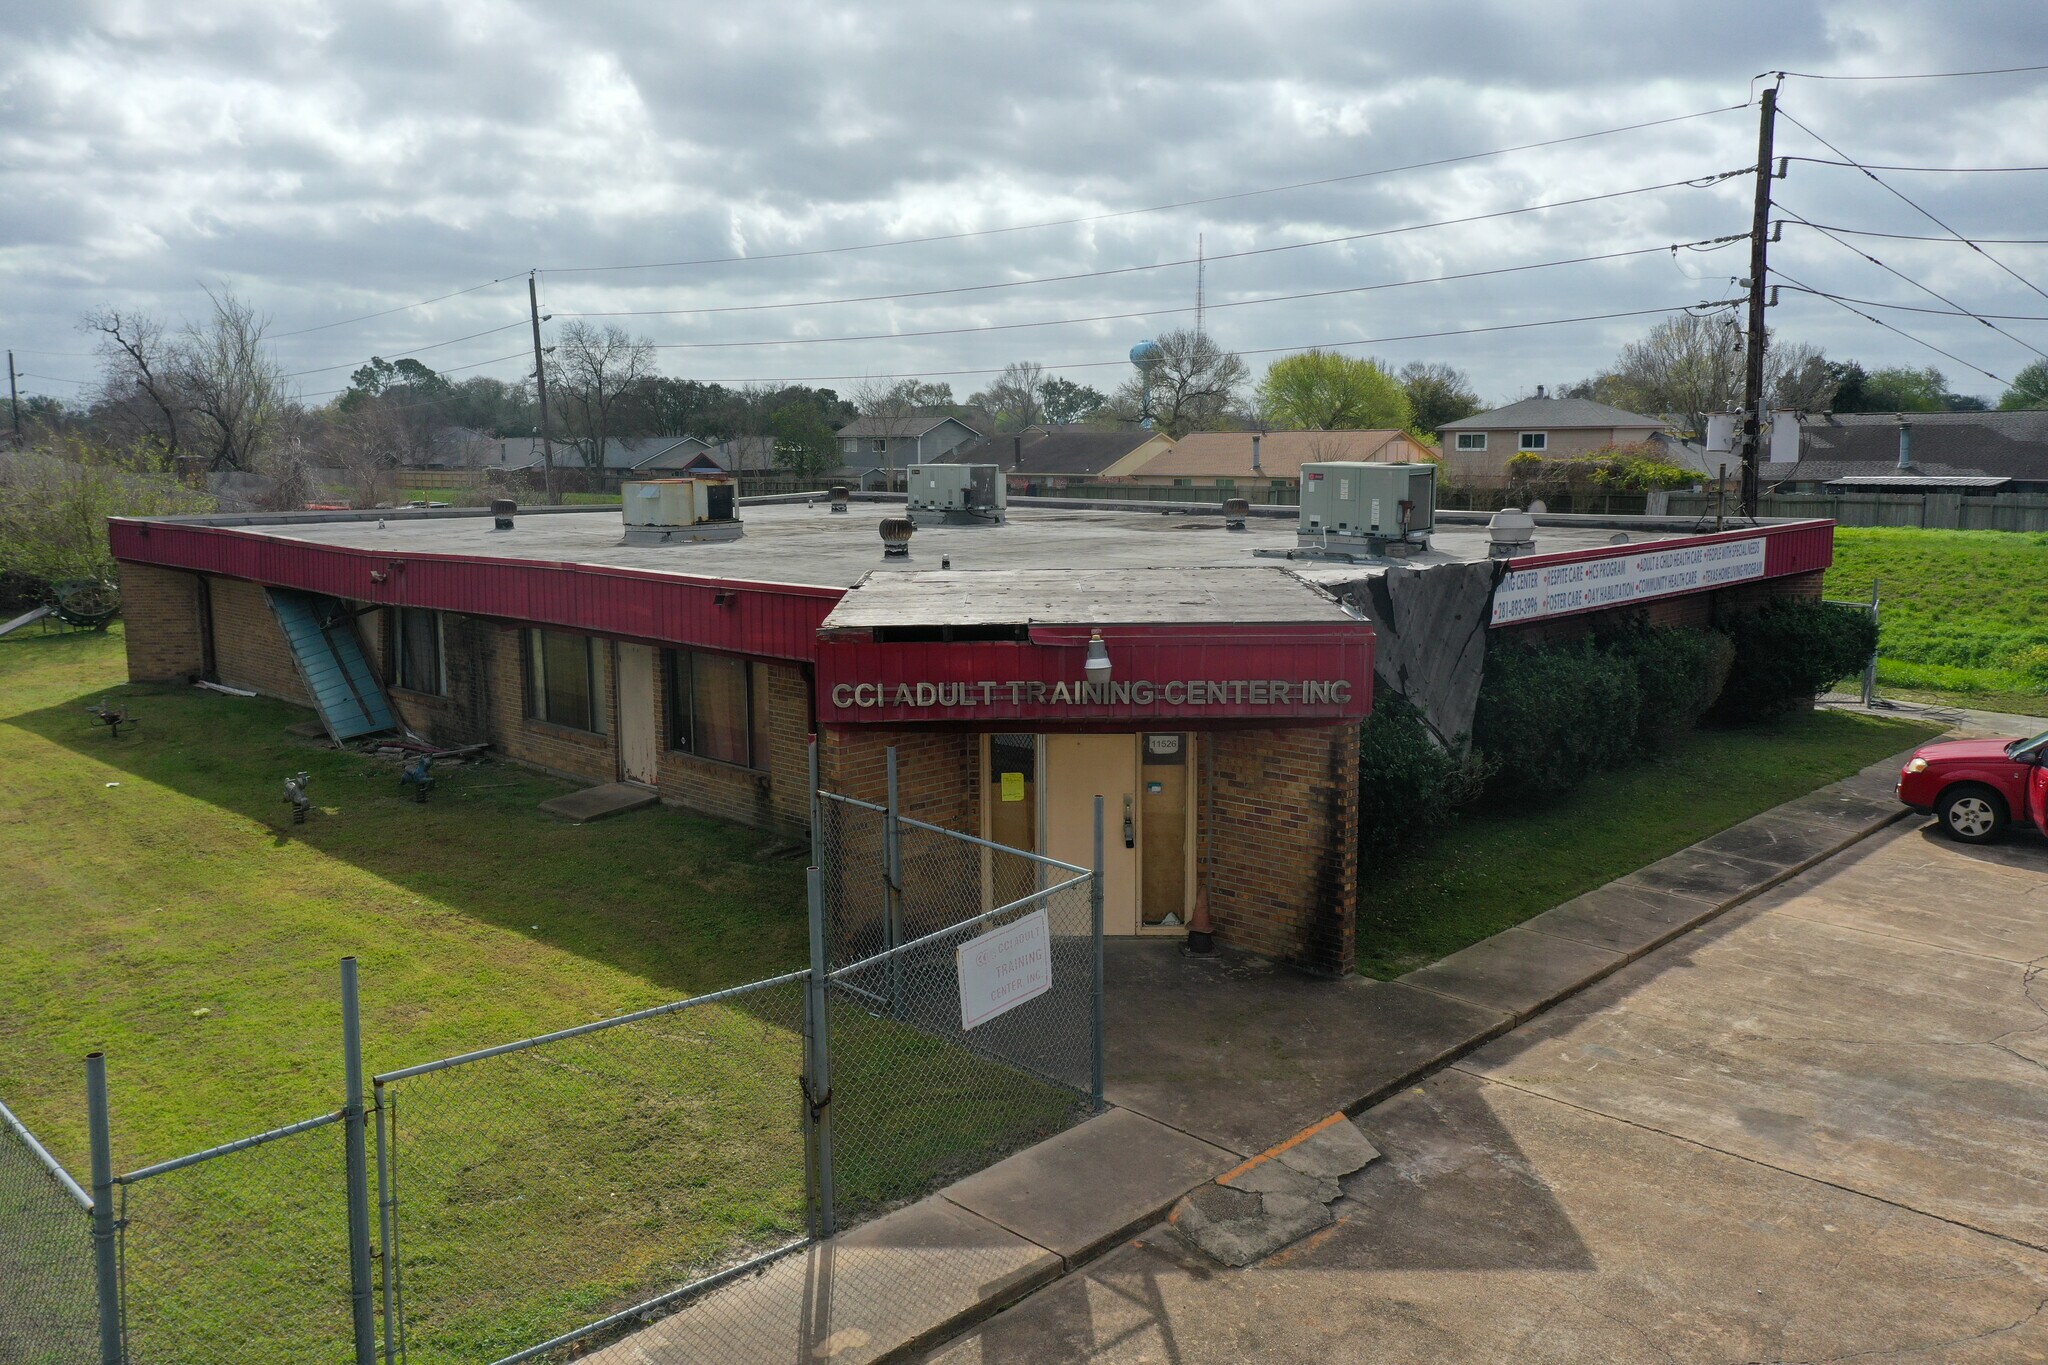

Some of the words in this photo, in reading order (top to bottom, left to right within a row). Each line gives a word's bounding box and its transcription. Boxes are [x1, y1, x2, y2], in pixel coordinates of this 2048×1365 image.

[1640, 556, 1655, 572] ADULT
[1660, 554, 1673, 569] CHILD
[1674, 551, 1690, 567] HEALTH
[1691, 550, 1702, 564] CARE
[1706, 547, 1722, 562] PEOPLE
[1732, 543, 1747, 558] SPECIAL
[1748, 541, 1760, 555] NEEDS
[1547, 568, 1568, 586] RESPITE
[1568, 566, 1584, 582] CARE
[1589, 564, 1599, 580] HCS
[1600, 560, 1626, 578] PROGRAM
[1516, 572, 1538, 590] CENTER
[1638, 576, 1668, 593] COMMUNITY
[1668, 573, 1685, 588] HEALTH
[1686, 570, 1698, 586] CARE
[1546, 592, 1567, 610] FOSTER
[1568, 590, 1582, 607] CARE
[1588, 588, 1600, 604] DAY
[1498, 596, 1538, 619] 281-893-3996
[832, 682, 885, 708] CCI
[893, 681, 997, 707] ADULT
[1005, 680, 1154, 706] TRAINING
[1164, 680, 1291, 705] CENTER
[1302, 680, 1352, 704] INC
[1151, 739, 1177, 748] 11526
[998, 939, 1013, 954] CCI
[1014, 926, 1040, 948] ADULT
[996, 948, 1042, 978] TRAINING
